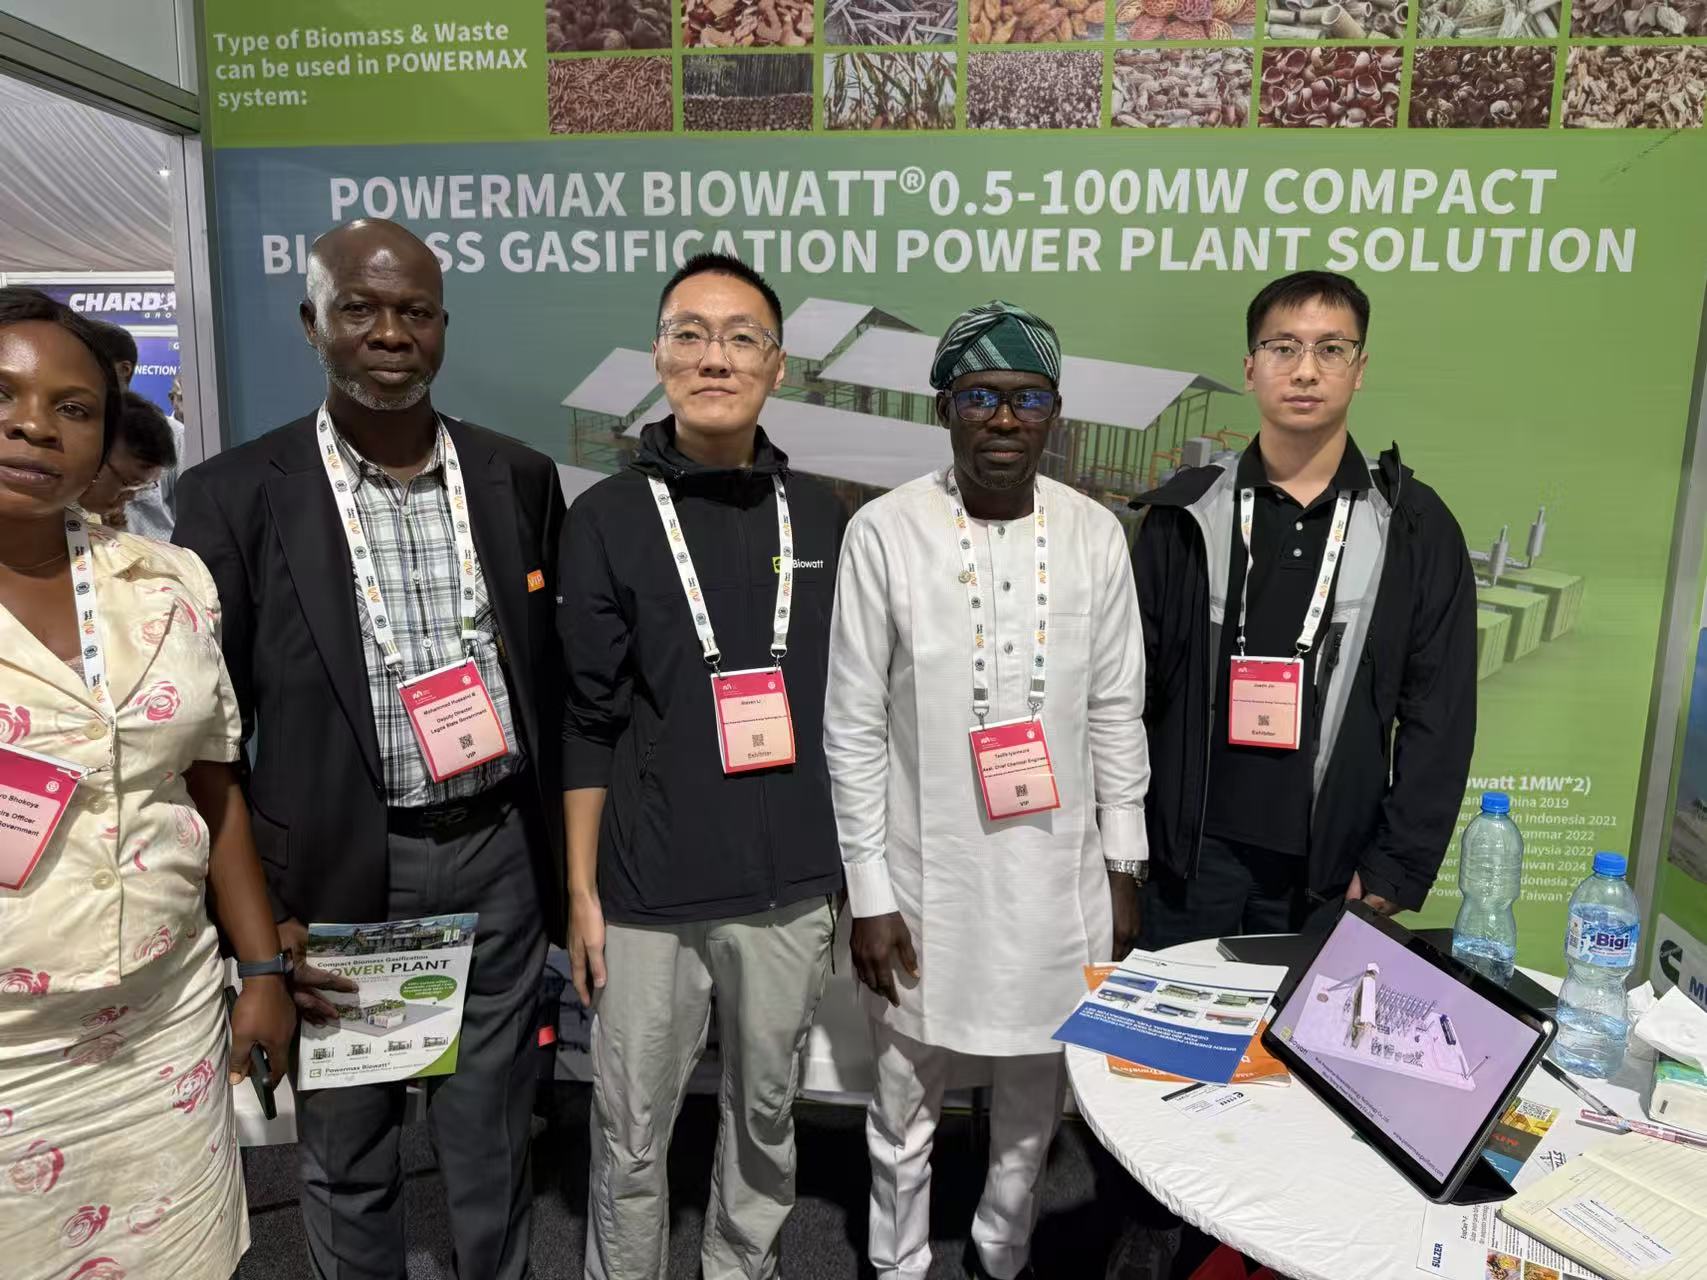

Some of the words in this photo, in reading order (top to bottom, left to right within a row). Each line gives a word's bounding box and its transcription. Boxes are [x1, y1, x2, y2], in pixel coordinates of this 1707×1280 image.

[213, 33, 270, 56] Type
[276, 29, 300, 50] of
[305, 27, 405, 48] Biomass
[410, 24, 429, 44] &
[434, 21, 509, 43] Waste
[216, 62, 256, 80] can
[261, 58, 290, 78] be
[295, 54, 350, 77] used
[358, 53, 379, 74] in
[386, 49, 528, 74] POWERMAX
[218, 87, 308, 112] system:
[330, 173, 627, 220] POWERMAX
[1264, 168, 1558, 214] COMPACT
[262, 231, 485, 274] BISS
[896, 228, 1102, 273] POWER
[1120, 227, 1311, 272] PLANT
[1324, 227, 1636, 274] SOLUTION
[134, 365, 176, 376] NECTION
[792, 558, 824, 568] Biowatt
[1510, 797, 1536, 808] hina
[1540, 798, 1569, 808] 2019
[12, 812, 36, 824] Officer
[1526, 813, 1585, 825] Indonesia
[1588, 816, 1616, 826] 2021
[1566, 830, 1594, 841] 2022
[1524, 844, 1561, 856] laysia
[1564, 846, 1593, 856] 2022
[1557, 862, 1587, 872] 2024
[1521, 875, 1568, 886] donesia
[1521, 890, 1563, 902] Taiwan
[1596, 932, 1628, 950] Bigi
[330, 965, 385, 977] OWER
[391, 960, 451, 972] PLANT
[1432, 1243, 1443, 1268] SULZER
